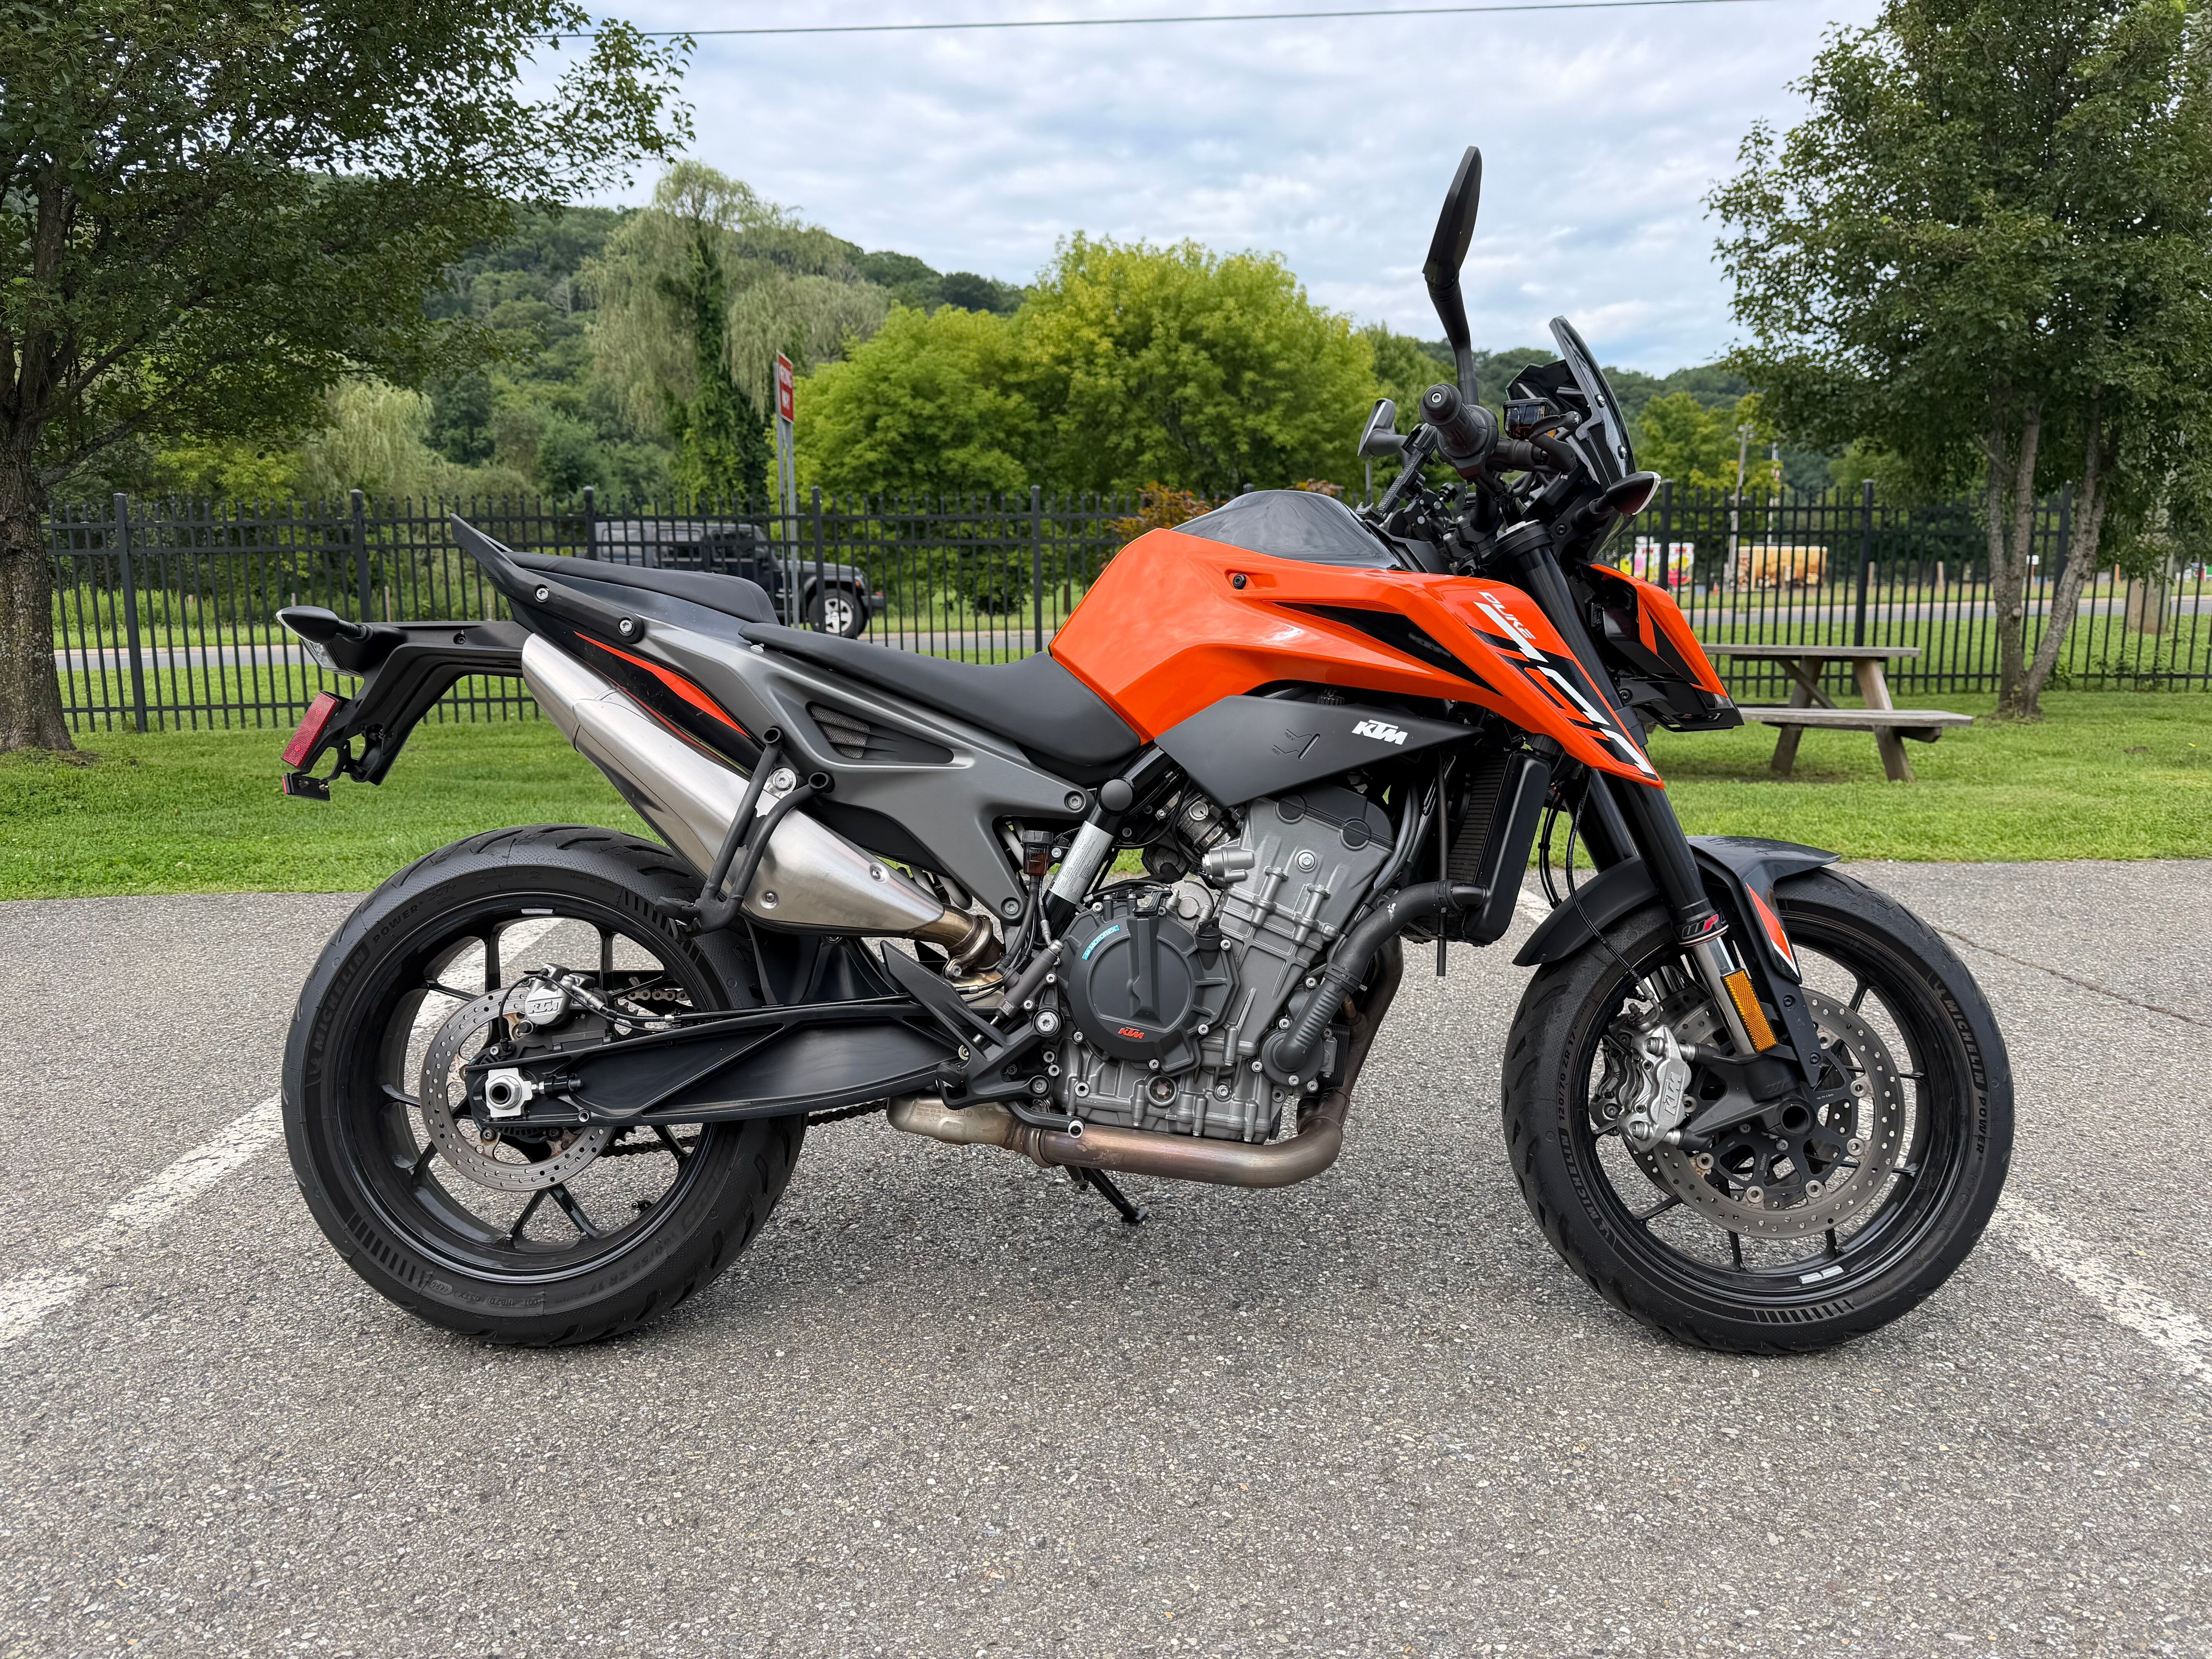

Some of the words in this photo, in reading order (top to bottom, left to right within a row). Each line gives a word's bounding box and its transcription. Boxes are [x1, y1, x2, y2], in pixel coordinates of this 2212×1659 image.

[1479, 591, 1536, 640] DUKE
[1283, 732, 1295, 741] max
[1352, 720, 1408, 745] KTM
[1088, 925, 1117, 950] MOTOREX
[313, 949, 367, 1052] MICHELIN
[373, 904, 419, 944] POWER
[528, 1000, 559, 1014] KTM
[1118, 1027, 1144, 1040] KTM
[1568, 1031, 1576, 1046] 17
[1562, 1049, 1571, 1068] ZR
[1944, 999, 1984, 1084] MICHELIN
[1976, 1096, 1987, 1154] POWER
[1663, 1072, 1682, 1116] KTM
[1561, 1134, 1599, 1220] MICHELIN
[587, 1281, 605, 1296] 17
[609, 1269, 628, 1286] ZR
